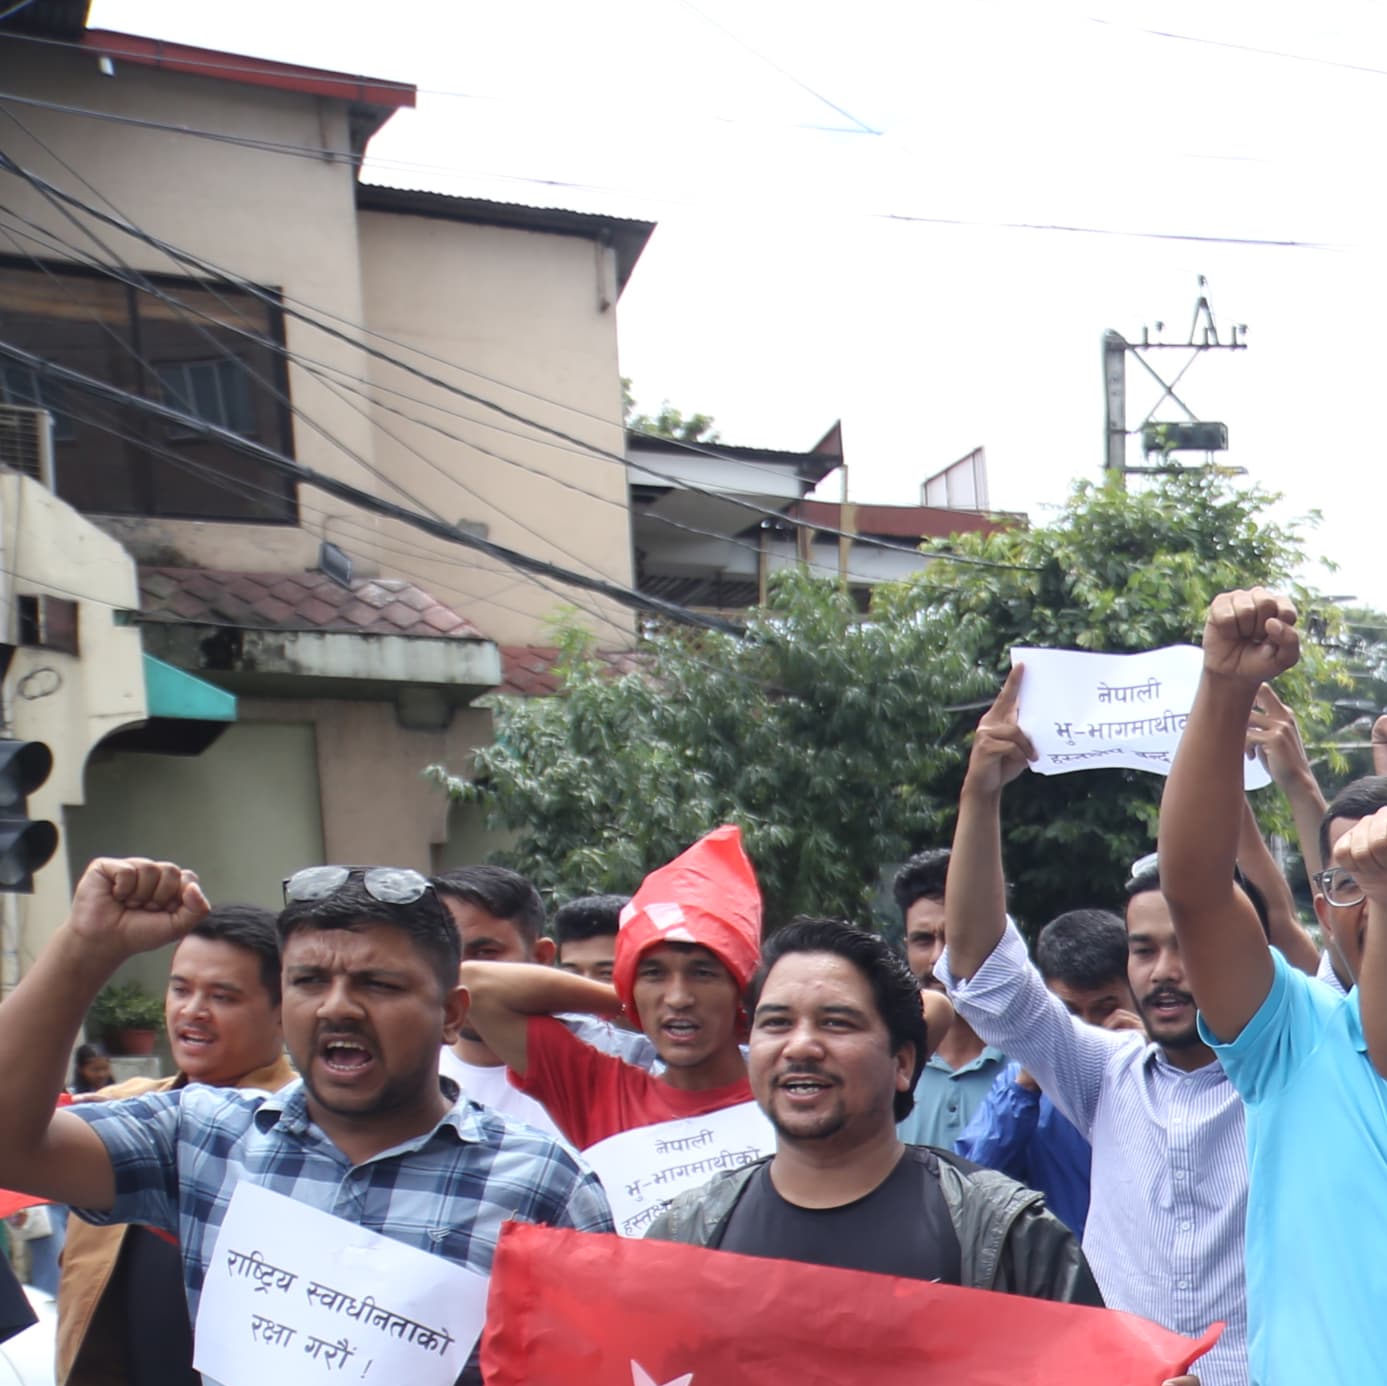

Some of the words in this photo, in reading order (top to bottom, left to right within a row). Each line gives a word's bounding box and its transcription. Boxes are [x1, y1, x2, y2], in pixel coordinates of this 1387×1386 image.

[1097, 677, 1162, 704] नेपाली
[655, 1129, 715, 1155] नेपाली
[227, 1249, 298, 1294] राष्ट्रिय
[306, 1281, 455, 1356] स्वाधीनताको
[251, 1314, 297, 1348] रक्षा
[360, 1359, 373, 1379] !
